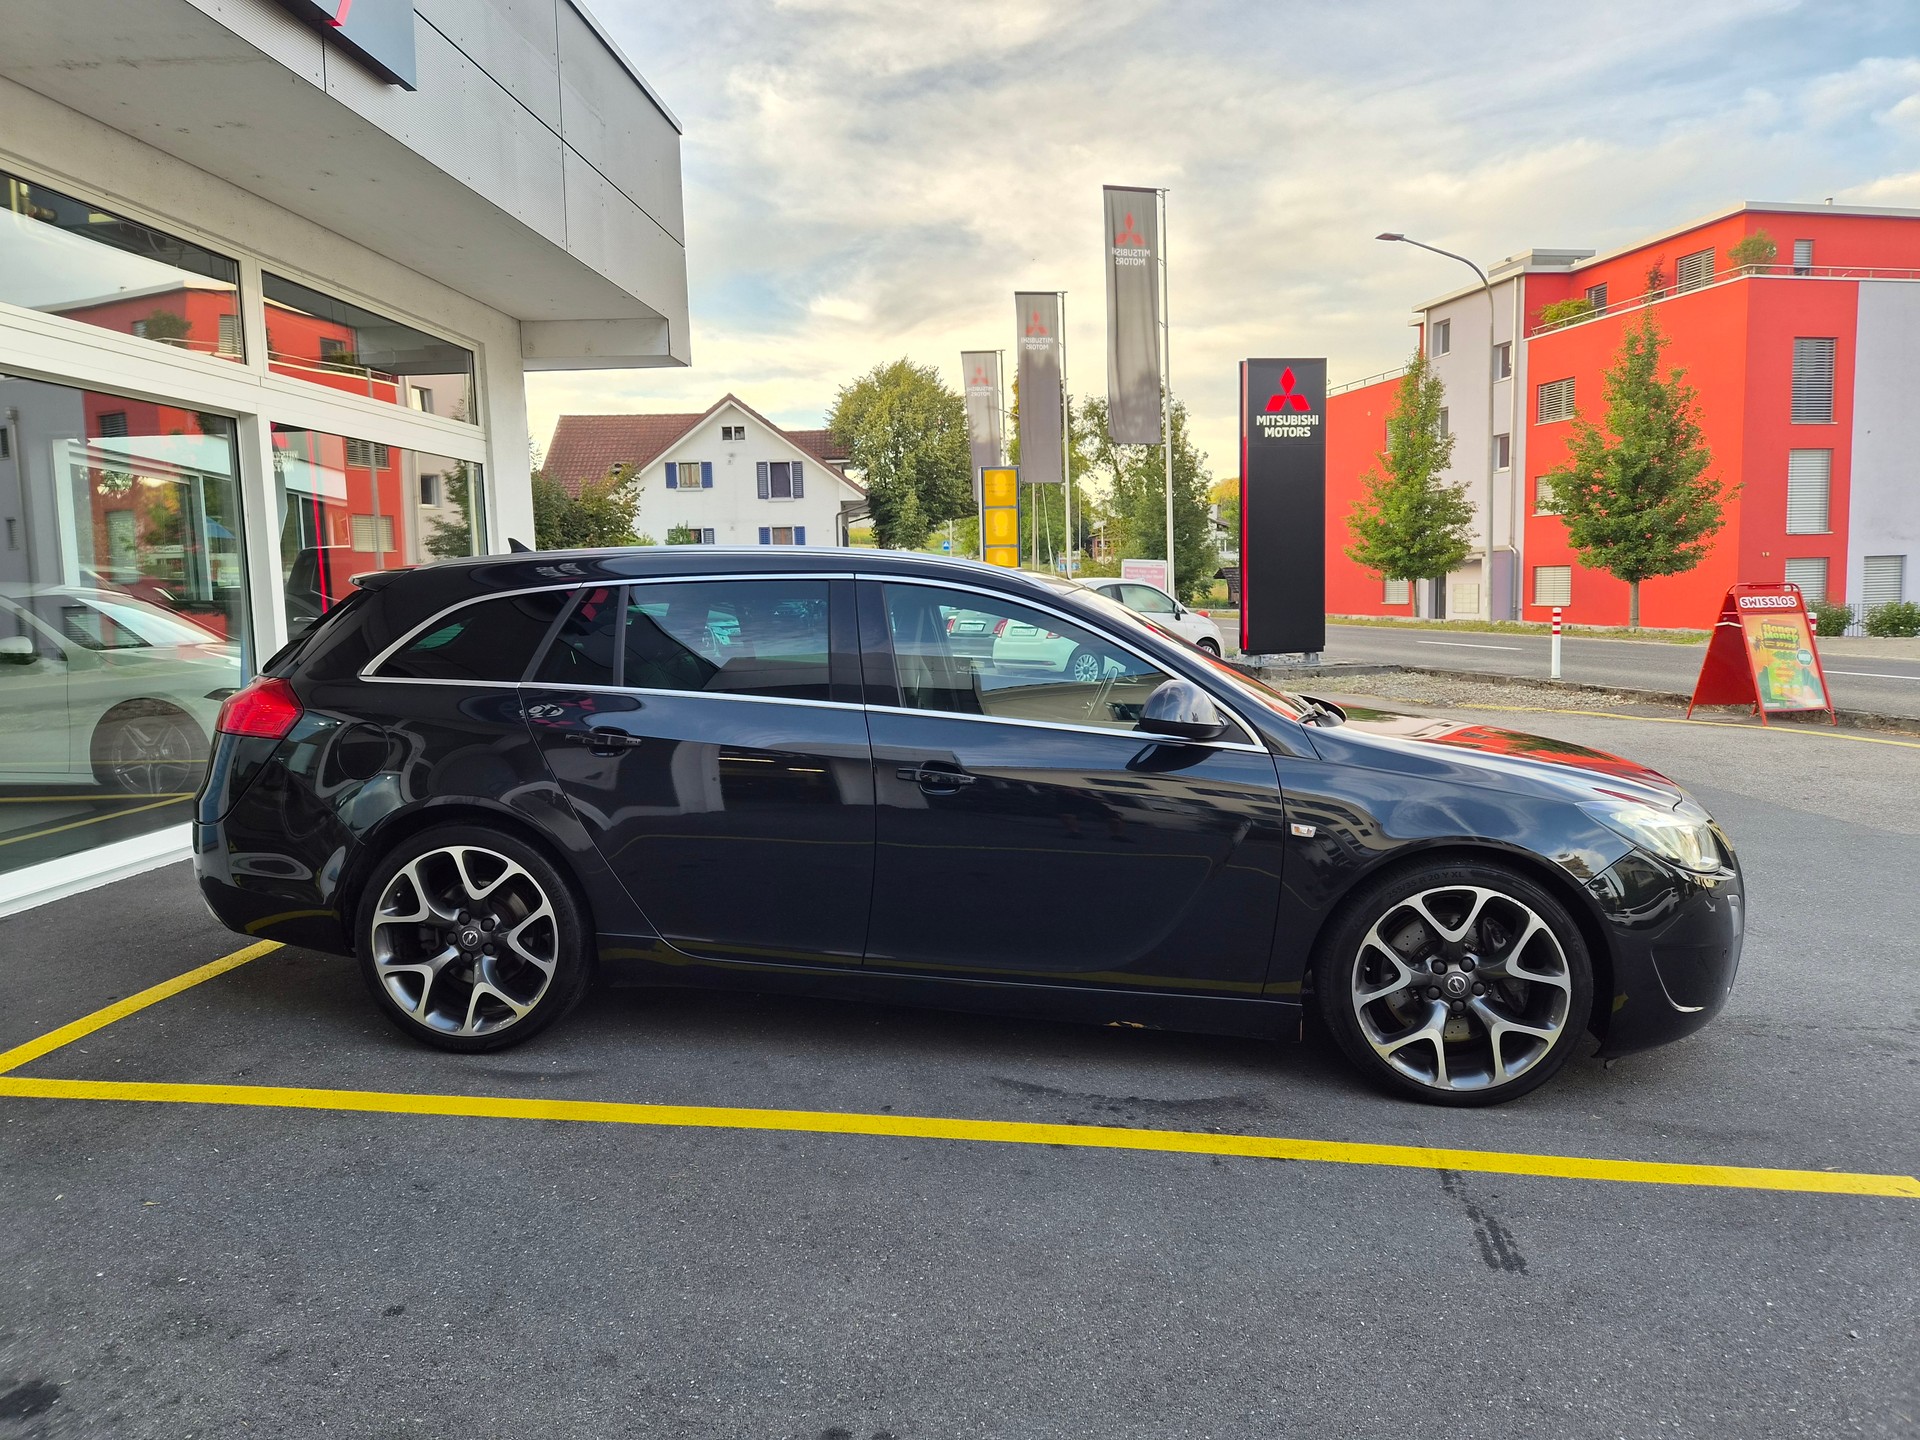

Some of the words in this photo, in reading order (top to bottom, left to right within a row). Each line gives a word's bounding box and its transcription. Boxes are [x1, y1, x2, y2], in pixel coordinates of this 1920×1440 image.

[1256, 415, 1319, 426] MITSUBISHI
[1264, 426, 1311, 438] MOTORS
[1740, 596, 1797, 608] SWISSLOS
[1763, 624, 1797, 635] Honey
[1764, 632, 1798, 642] Money
[1428, 873, 1440, 881] 20
